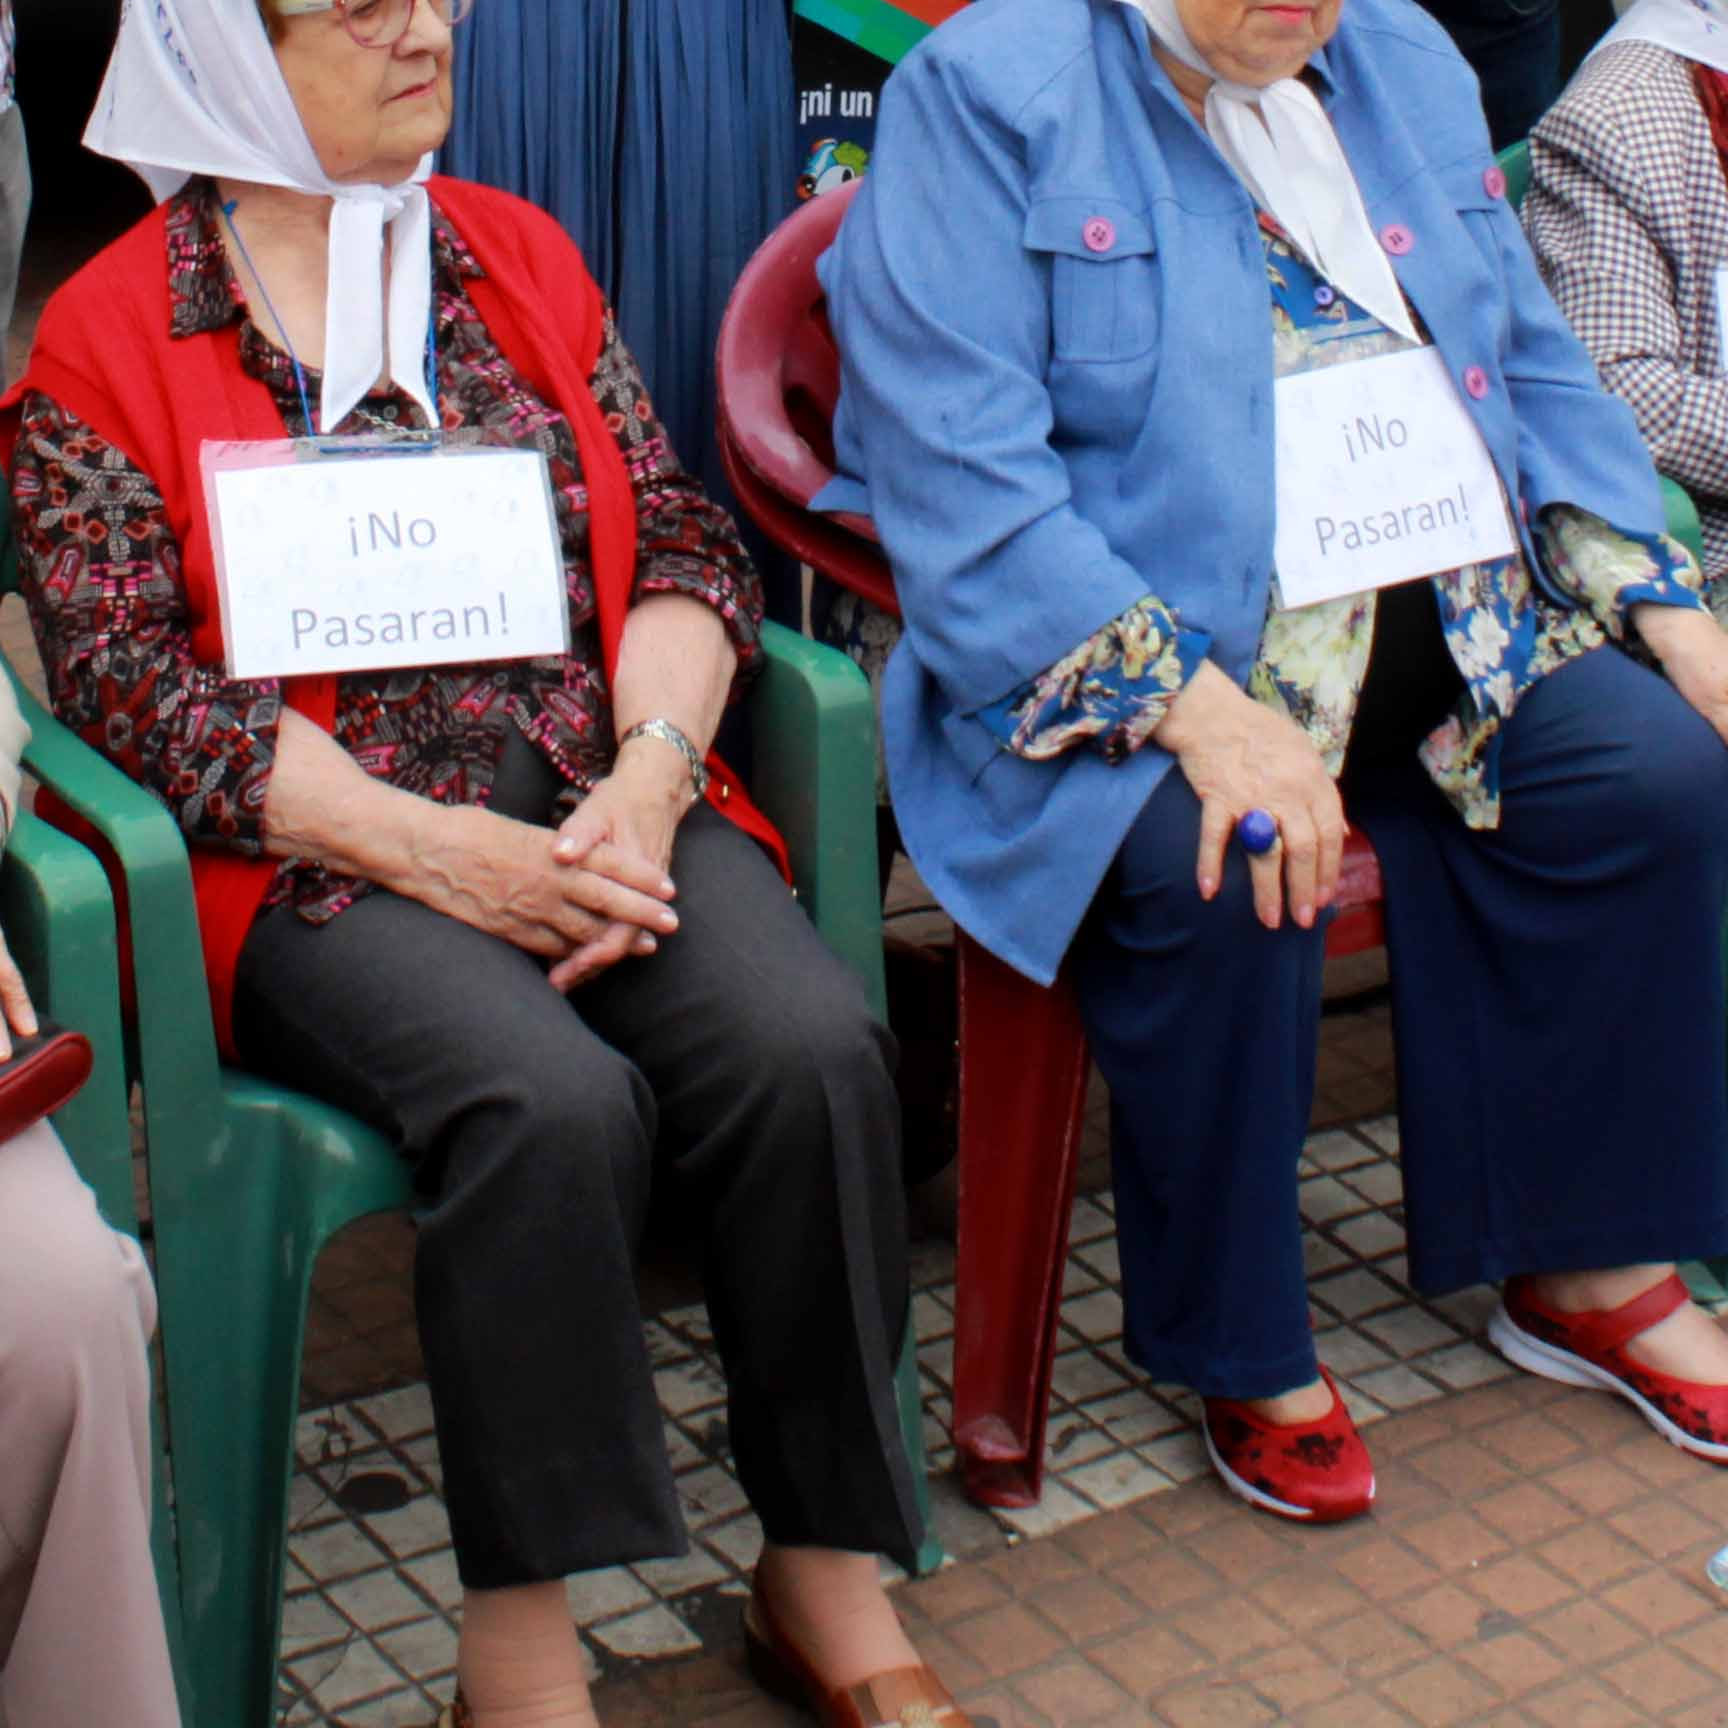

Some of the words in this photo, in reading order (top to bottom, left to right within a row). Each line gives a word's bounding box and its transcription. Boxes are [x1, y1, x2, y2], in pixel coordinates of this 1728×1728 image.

[800, 83, 833, 125] ¡ni
[840, 88, 873, 118] un
[1342, 413, 1409, 463] ¡No
[348, 511, 437, 557] ¡No
[1314, 483, 1472, 556] Pasaran!
[291, 591, 510, 650] Pasaran!
